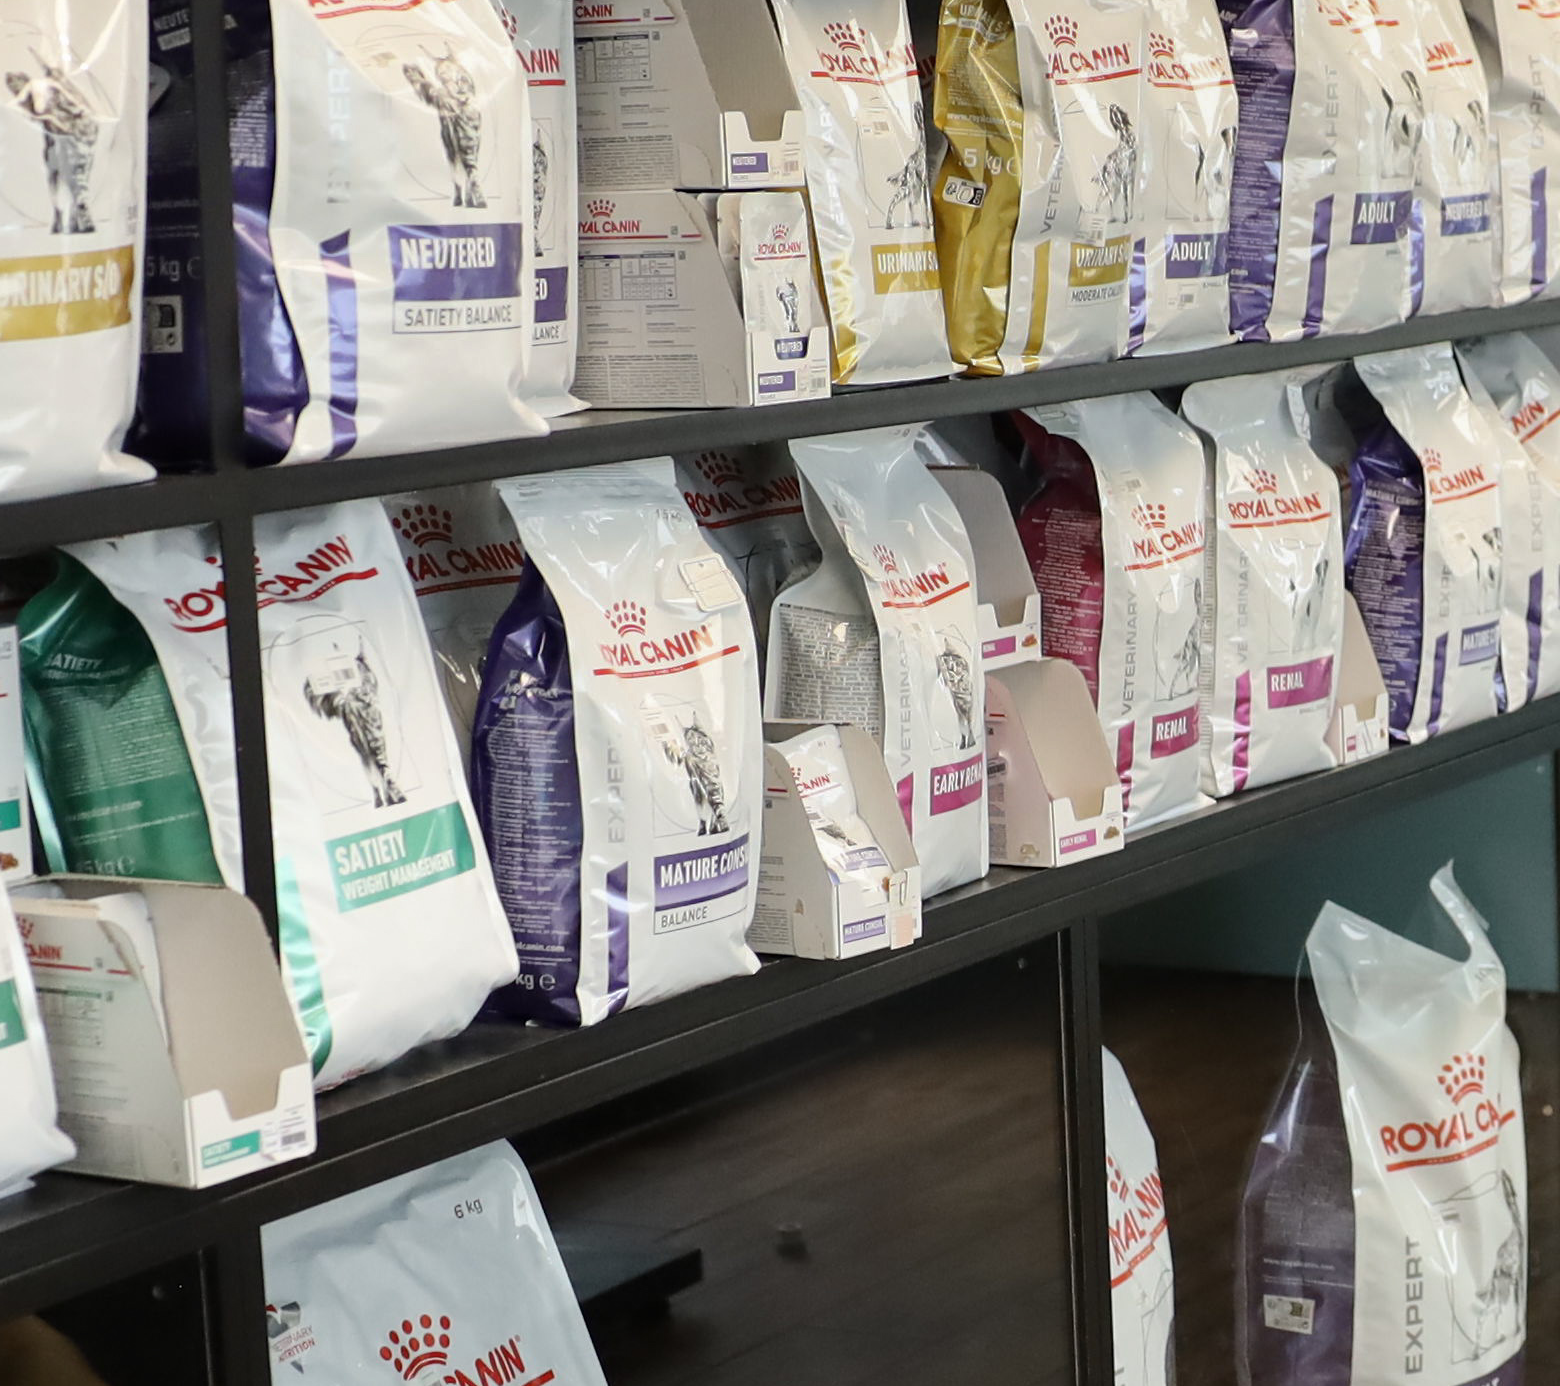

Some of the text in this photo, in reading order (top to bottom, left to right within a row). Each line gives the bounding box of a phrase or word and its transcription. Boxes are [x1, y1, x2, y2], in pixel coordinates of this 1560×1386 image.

[575, 3, 614, 18] CANIN
[1068, 42, 1131, 71] CANIN
[984, 153, 1003, 175] kg
[1357, 201, 1396, 224] ADULT
[601, 219, 641, 234] CANIN
[400, 235, 496, 271] NEUTERED
[778, 240, 803, 254] CANIN
[1169, 241, 1211, 262] ADULT
[158, 254, 181, 280] kg
[876, 252, 928, 276] URINARY
[91, 258, 122, 302] S/O
[1071, 287, 1107, 302] MODERATE
[404, 304, 514, 328] SATIETY BALANCE
[1439, 465, 1484, 492] CANIN
[684, 482, 747, 519] ROYAL
[1227, 492, 1322, 519] ROYAL CANIN
[260, 535, 357, 601] CANIN
[446, 539, 524, 577] CANIN
[641, 624, 714, 663] CANIN
[1122, 589, 1138, 715] VETERINARY
[1462, 629, 1488, 650] MATURE
[1271, 670, 1305, 692] RENAL
[892, 627, 913, 768] VETERINARY
[1155, 715, 1188, 742] RENAL
[933, 771, 965, 797] EARLY
[334, 828, 406, 877] SATIETY
[1060, 837, 1076, 850] EARLY
[341, 849, 456, 903] WEIGHT MANAGEMENT
[659, 858, 720, 889] MATURE
[660, 906, 709, 929] BALANCE
[844, 923, 865, 938] MATURE
[1379, 1101, 1473, 1157] ROYAL
[453, 1198, 484, 1220] 6 kg
[1403, 1234, 1425, 1375] EXPERT
